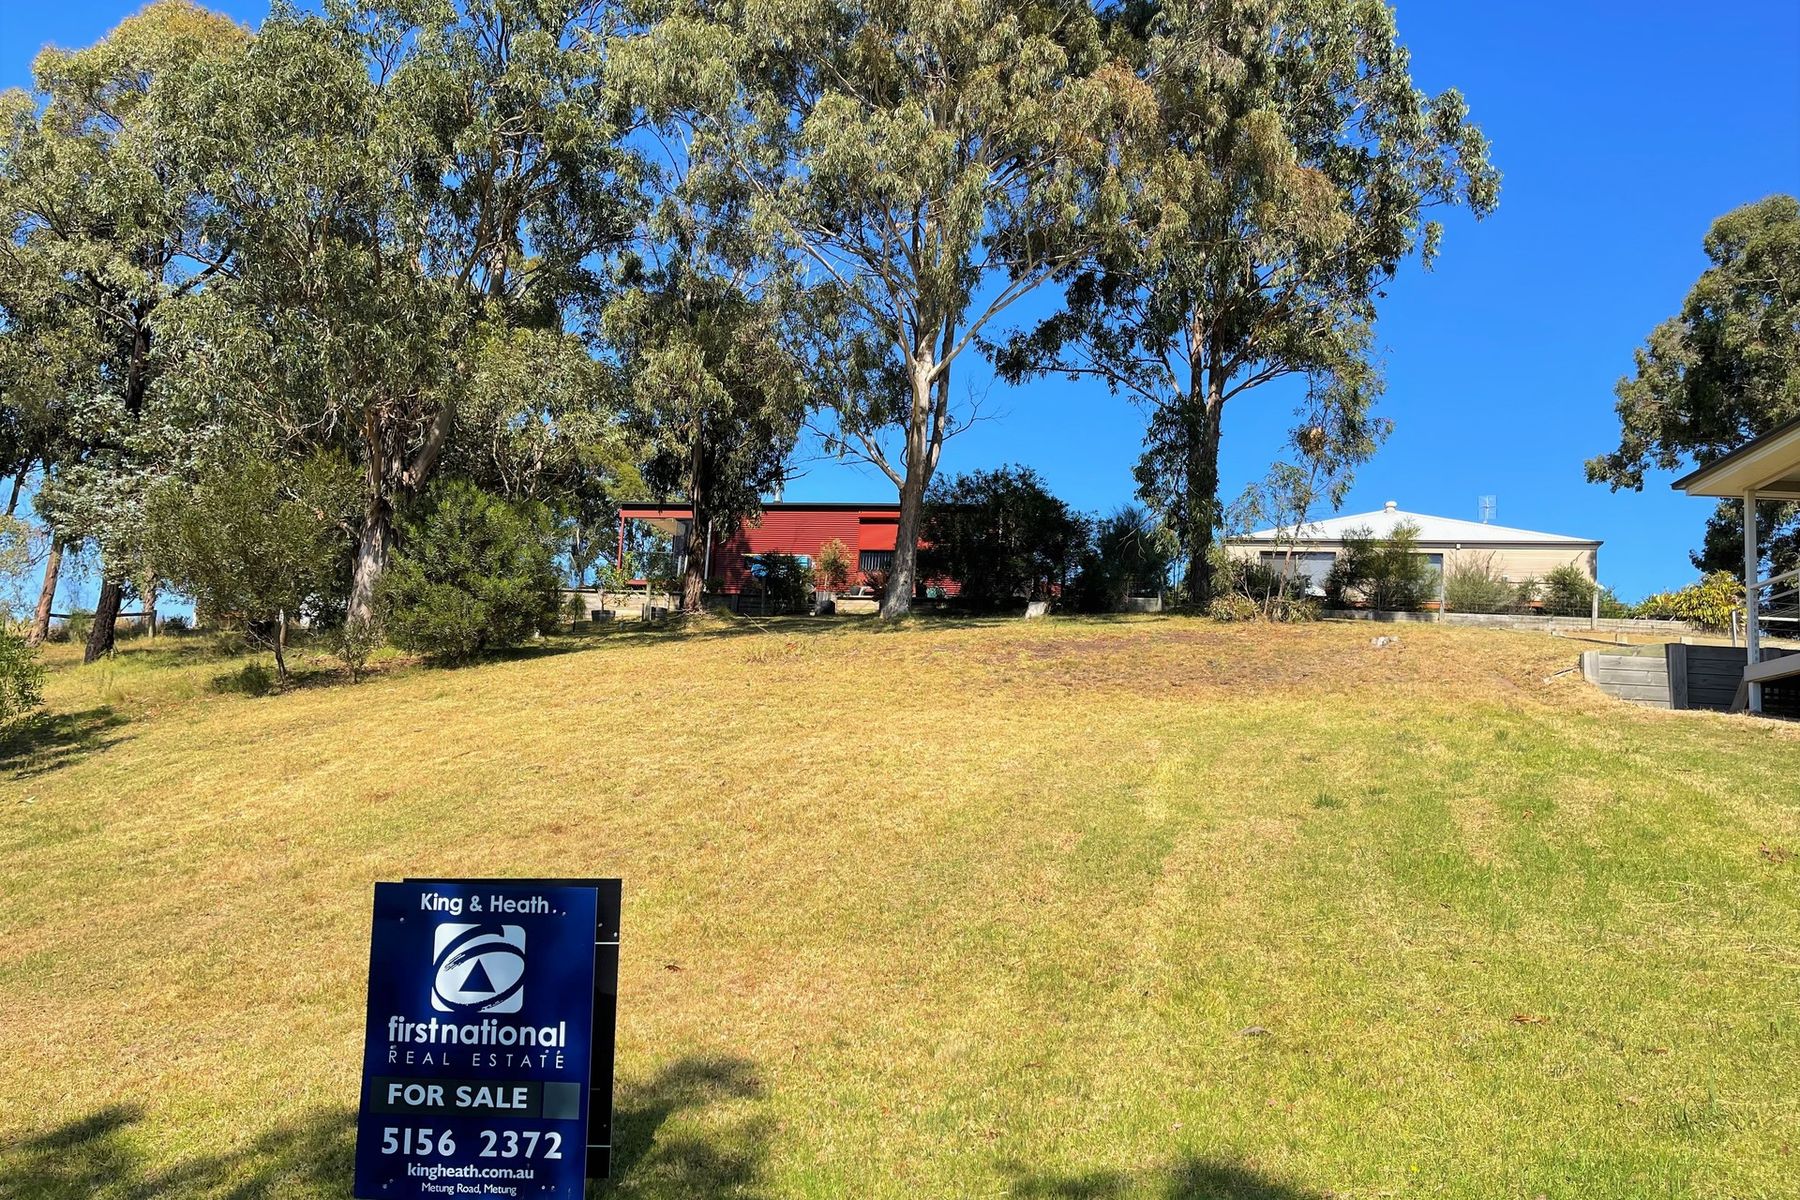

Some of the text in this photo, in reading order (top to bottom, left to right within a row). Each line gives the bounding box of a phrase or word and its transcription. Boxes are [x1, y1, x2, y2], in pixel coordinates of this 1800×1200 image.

[421, 893, 549, 916] King & Heath
[388, 1050, 564, 1069] REAL ESTATE
[387, 1083, 528, 1109] FOR SALE
[381, 1127, 562, 1160] 5156 2372
[407, 1162, 534, 1181] kingheath.com.au
[421, 1183, 517, 1196] Metung Road, Metung
